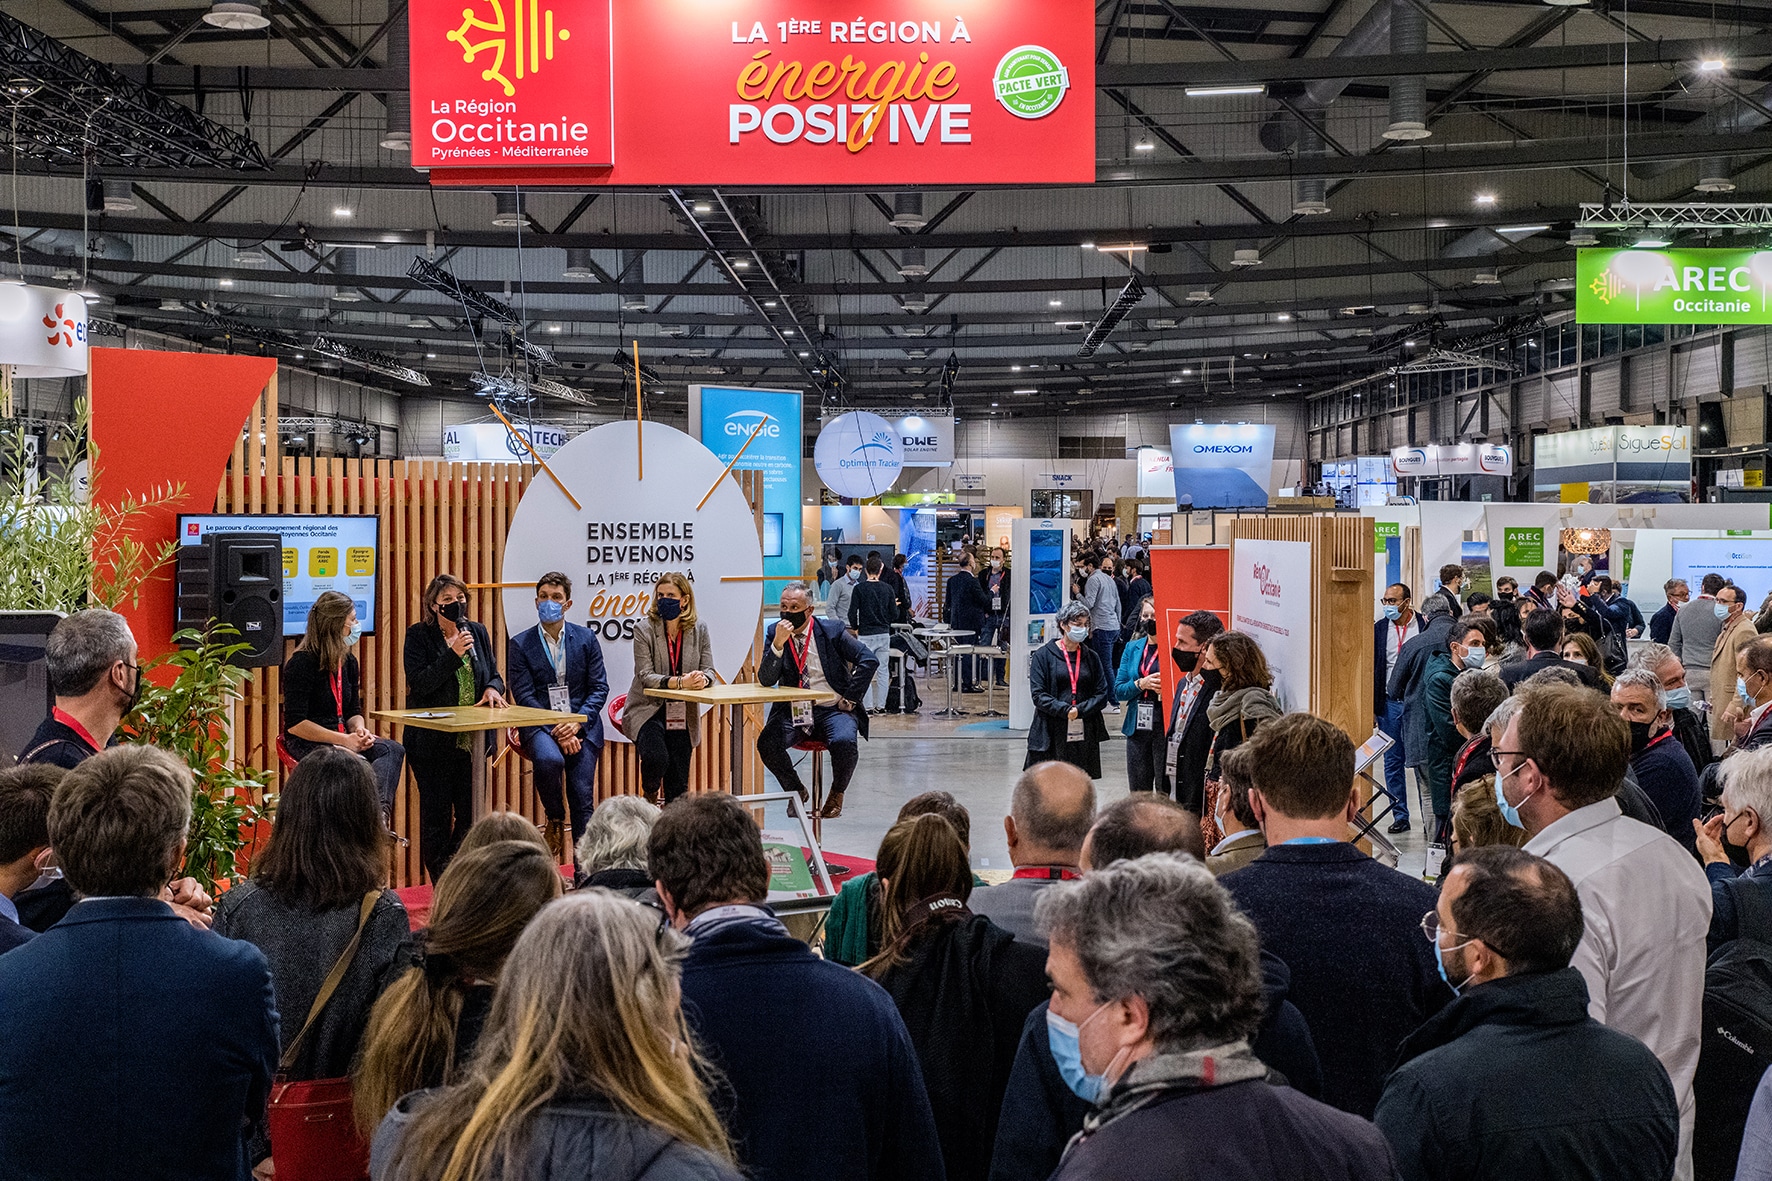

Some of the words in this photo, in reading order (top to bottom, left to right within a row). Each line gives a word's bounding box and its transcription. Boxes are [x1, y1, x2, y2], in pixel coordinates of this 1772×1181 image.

[732, 21, 768, 43] LA
[777, 17, 821, 43] 1ÈRE
[830, 16, 941, 43] RÉGION
[951, 15, 972, 43] À
[999, 79, 1032, 94] PACTE
[1035, 74, 1062, 88] VERT
[431, 100, 450, 114] La
[455, 98, 517, 117] Région
[736, 49, 960, 152] énergie
[431, 116, 589, 143] Occitanie
[729, 103, 972, 144] POSITIVE
[432, 146, 491, 160] Pyrénées
[502, 145, 589, 157] Méditerranée
[1653, 265, 1751, 292] AREC
[1673, 298, 1751, 313] Occitanie
[902, 436, 938, 446] DWE
[1193, 445, 1253, 453] OMEXOM
[1619, 434, 1687, 453] SigueSol
[840, 459, 877, 469] Optimum
[878, 458, 900, 468] Tracker
[243, 524, 302, 532] d'accompagnement
[303, 524, 327, 532] régional
[587, 522, 694, 540] ENSEMBLE
[1508, 532, 1541, 540] AREC
[587, 545, 695, 563] DEVENONS
[588, 573, 606, 586] LA
[609, 570, 630, 586] 1ÈRE
[633, 569, 662, 584] RÉG
[687, 568, 695, 583] À
[589, 588, 651, 618] éner
[929, 898, 963, 911] Canon
[1723, 1030, 1755, 1055] Columbia
